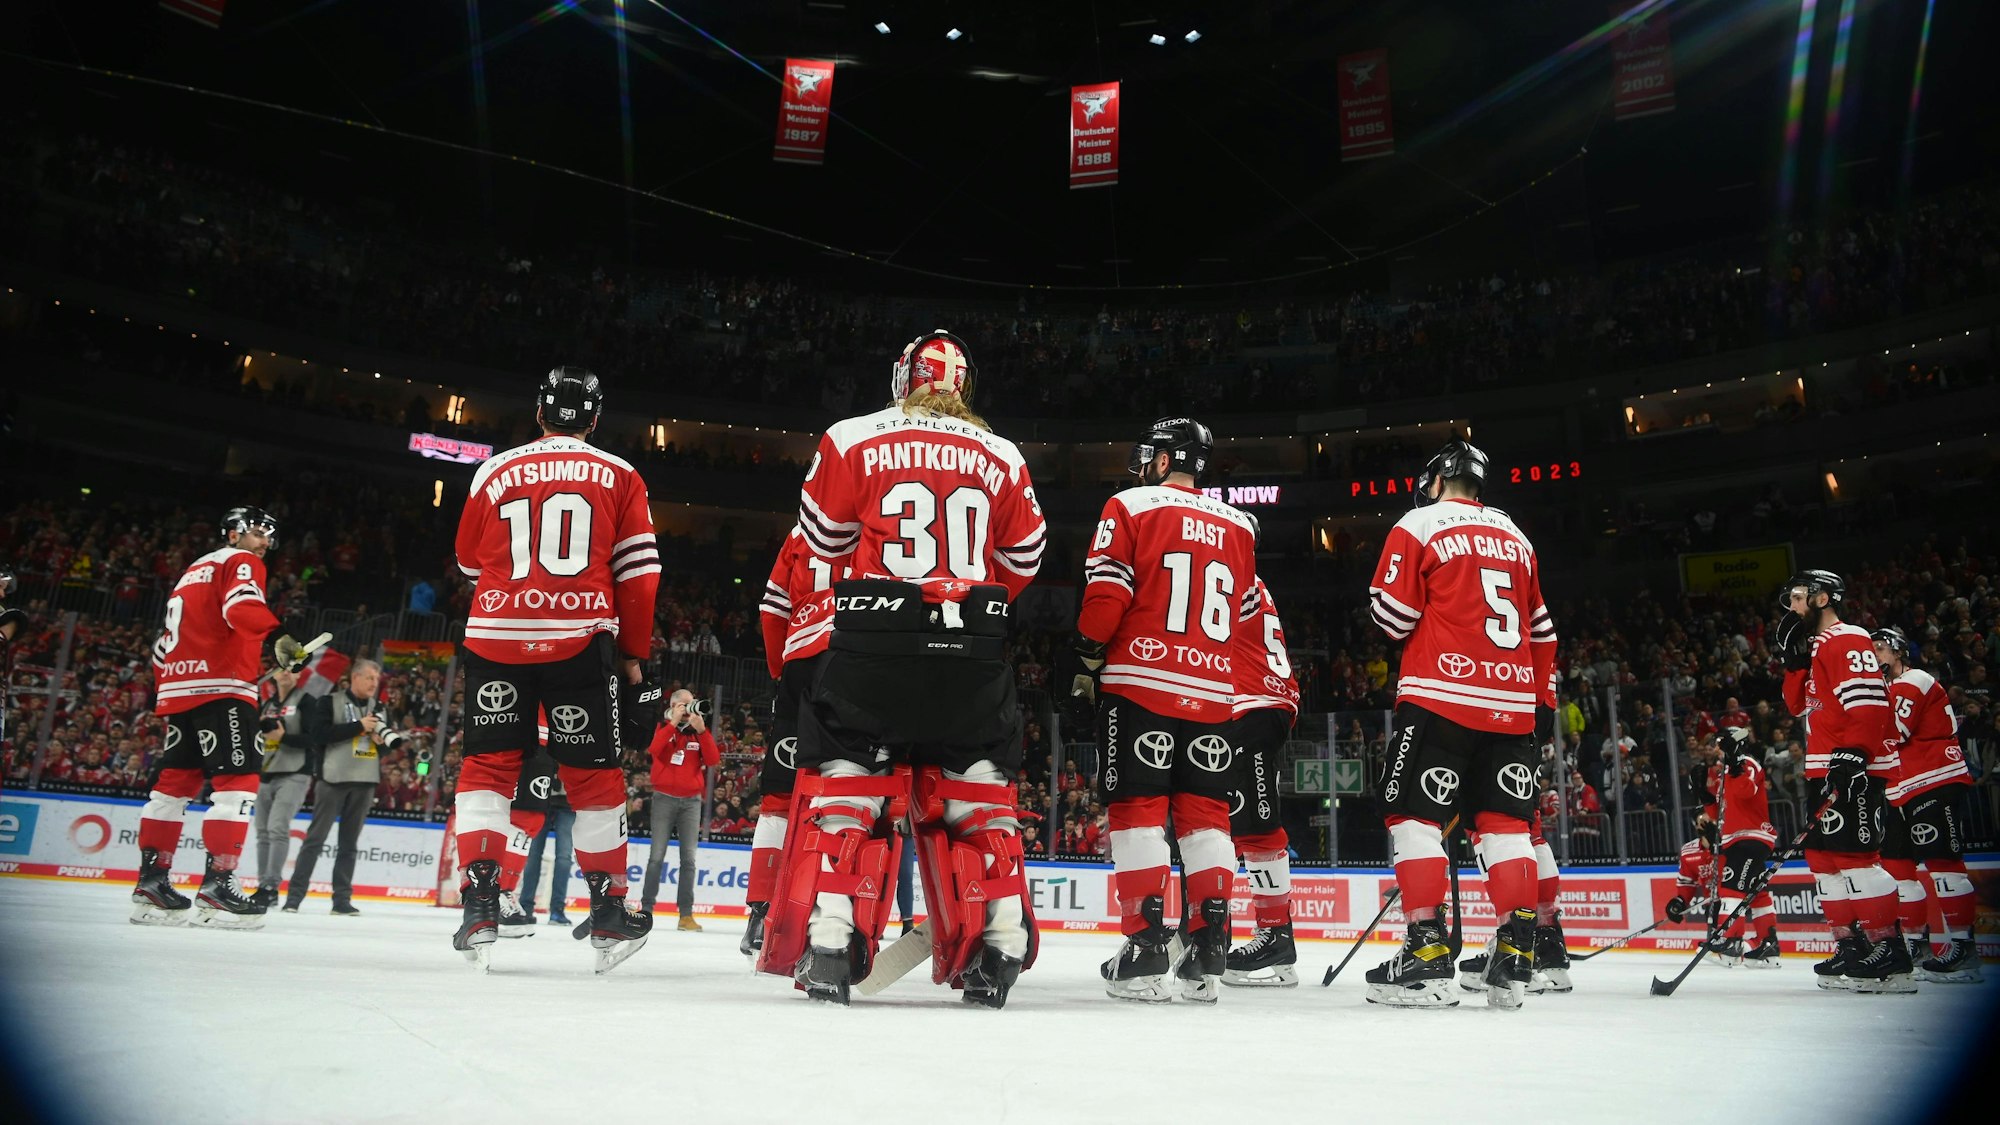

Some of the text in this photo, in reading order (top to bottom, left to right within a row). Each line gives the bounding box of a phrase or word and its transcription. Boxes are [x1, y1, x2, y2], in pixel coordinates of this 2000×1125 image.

[1621, 74, 1665, 94] 2002
[784, 101, 828, 113] Deutscher
[787, 113, 821, 125] Meister
[1348, 121, 1386, 138] 1995
[1074, 126, 1116, 137] Deutscher
[1078, 138, 1112, 149] Meister
[1077, 152, 1112, 167] 1988
[545, 394, 555, 405] 10
[584, 400, 593, 411] 10
[876, 418, 993, 448] STAHLWERK
[804, 450, 822, 482] 0
[1175, 450, 1187, 461] 16
[863, 441, 1005, 497] PANTKOWSKI
[1510, 461, 1581, 483] 2023
[485, 460, 615, 506] MATSUMOTO
[1023, 485, 1041, 517] 3
[1228, 486, 1279, 505] NOW
[498, 492, 593, 581] 10
[879, 480, 991, 582] 30
[1093, 518, 1116, 551] 16
[1182, 516, 1226, 551] BAST
[1430, 534, 1472, 564] VAN
[236, 563, 252, 580] 9
[1384, 553, 1403, 585] 5
[1712, 558, 1760, 573] Radio
[1720, 575, 1757, 589] Köln
[513, 588, 609, 611] TOYOTA
[836, 596, 905, 612] CCM
[1162, 552, 1234, 643] 16
[1480, 566, 1522, 652] 5
[165, 594, 184, 654] 9
[1480, 661, 1535, 684] TOYOT
[1846, 650, 1880, 673] 39
[228, 706, 242, 749] TOYOTA
[473, 713, 520, 726] TOYOTA
[611, 698, 622, 758] TOYOTA
[551, 731, 596, 744] TOYOTA
[1107, 707, 1118, 766] TOYOTA
[1391, 725, 1415, 778] TOYOTA
[1253, 751, 1267, 800] TOYOTA
[1944, 805, 1957, 838] TOYOTA
[1314, 884, 1336, 894] Haie
[1590, 891, 1621, 902] HAIE!
